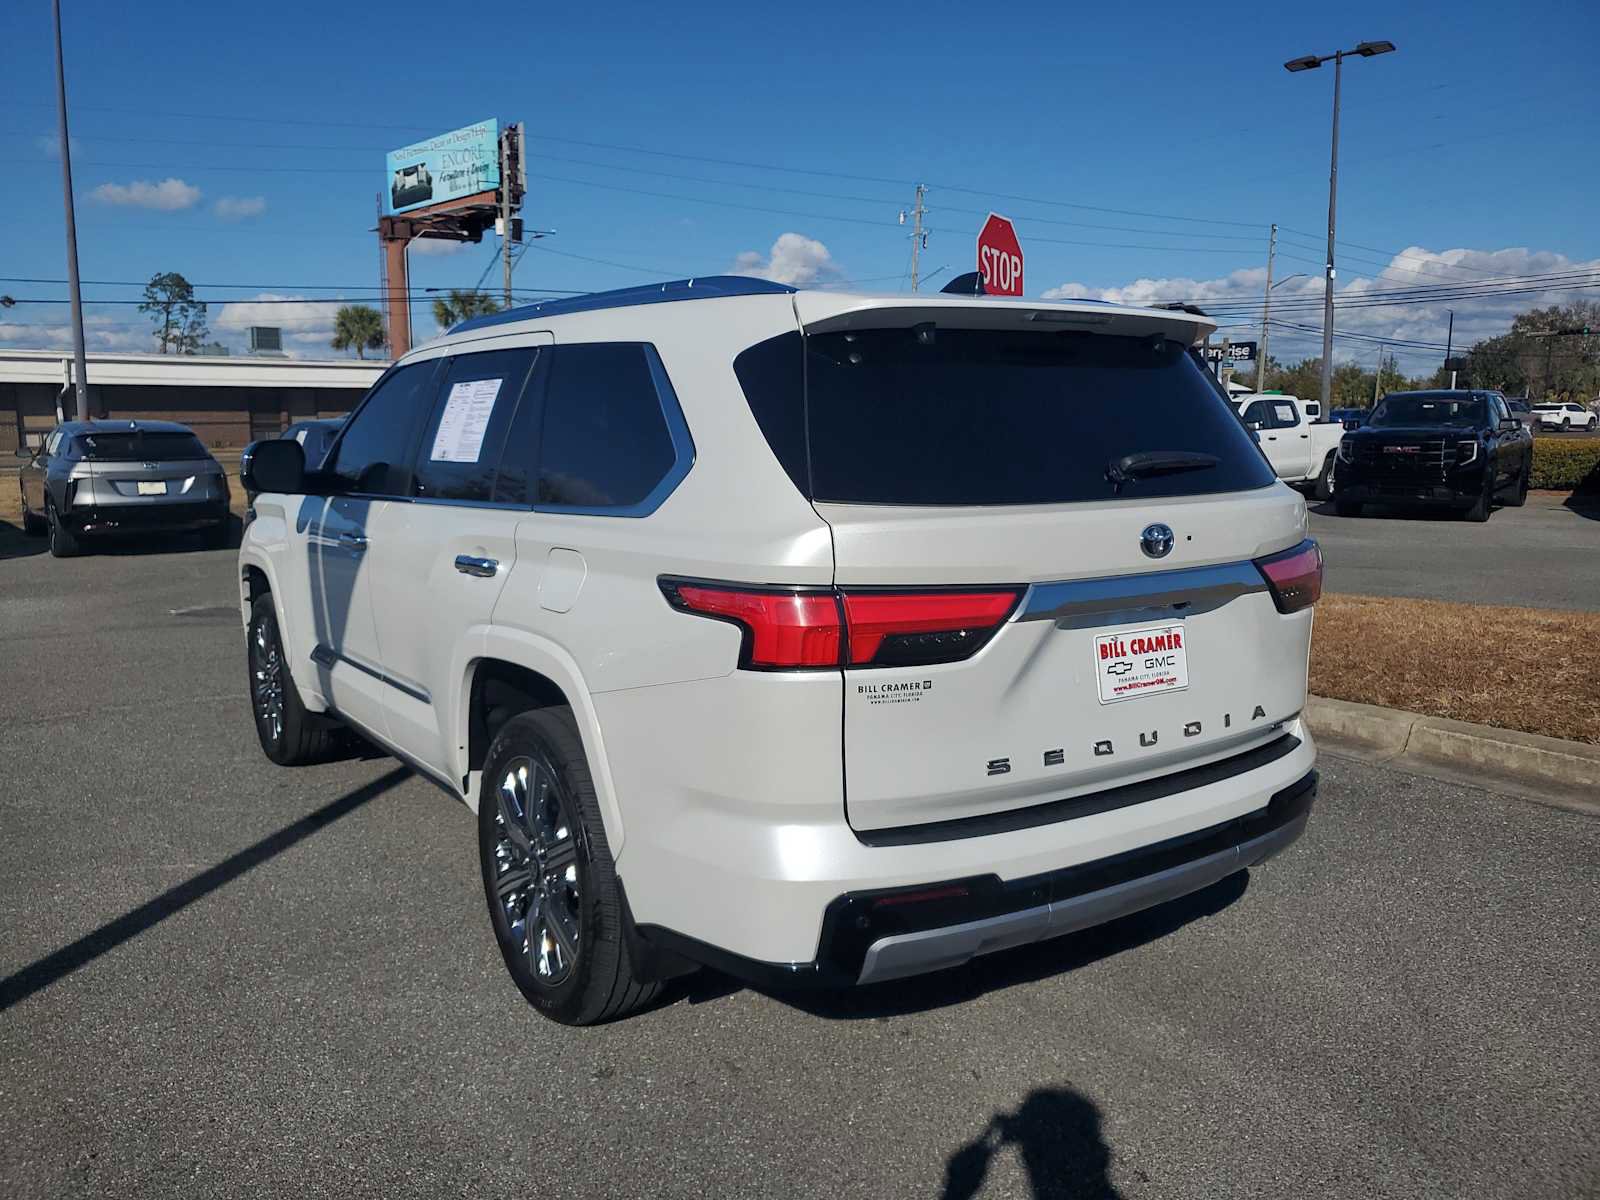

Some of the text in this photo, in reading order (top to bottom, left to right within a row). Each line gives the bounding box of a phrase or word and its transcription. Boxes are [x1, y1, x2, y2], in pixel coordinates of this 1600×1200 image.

[442, 144, 483, 169] ENCORE
[981, 244, 1021, 292] STOP
[1100, 634, 1182, 660] BILL CRAMER
[1144, 655, 1176, 669] GMC
[858, 685, 878, 693] BILL
[881, 682, 920, 692] CRAMER
[1118, 676, 1138, 684] PANAMA
[987, 705, 1266, 776] SEQUOIA
